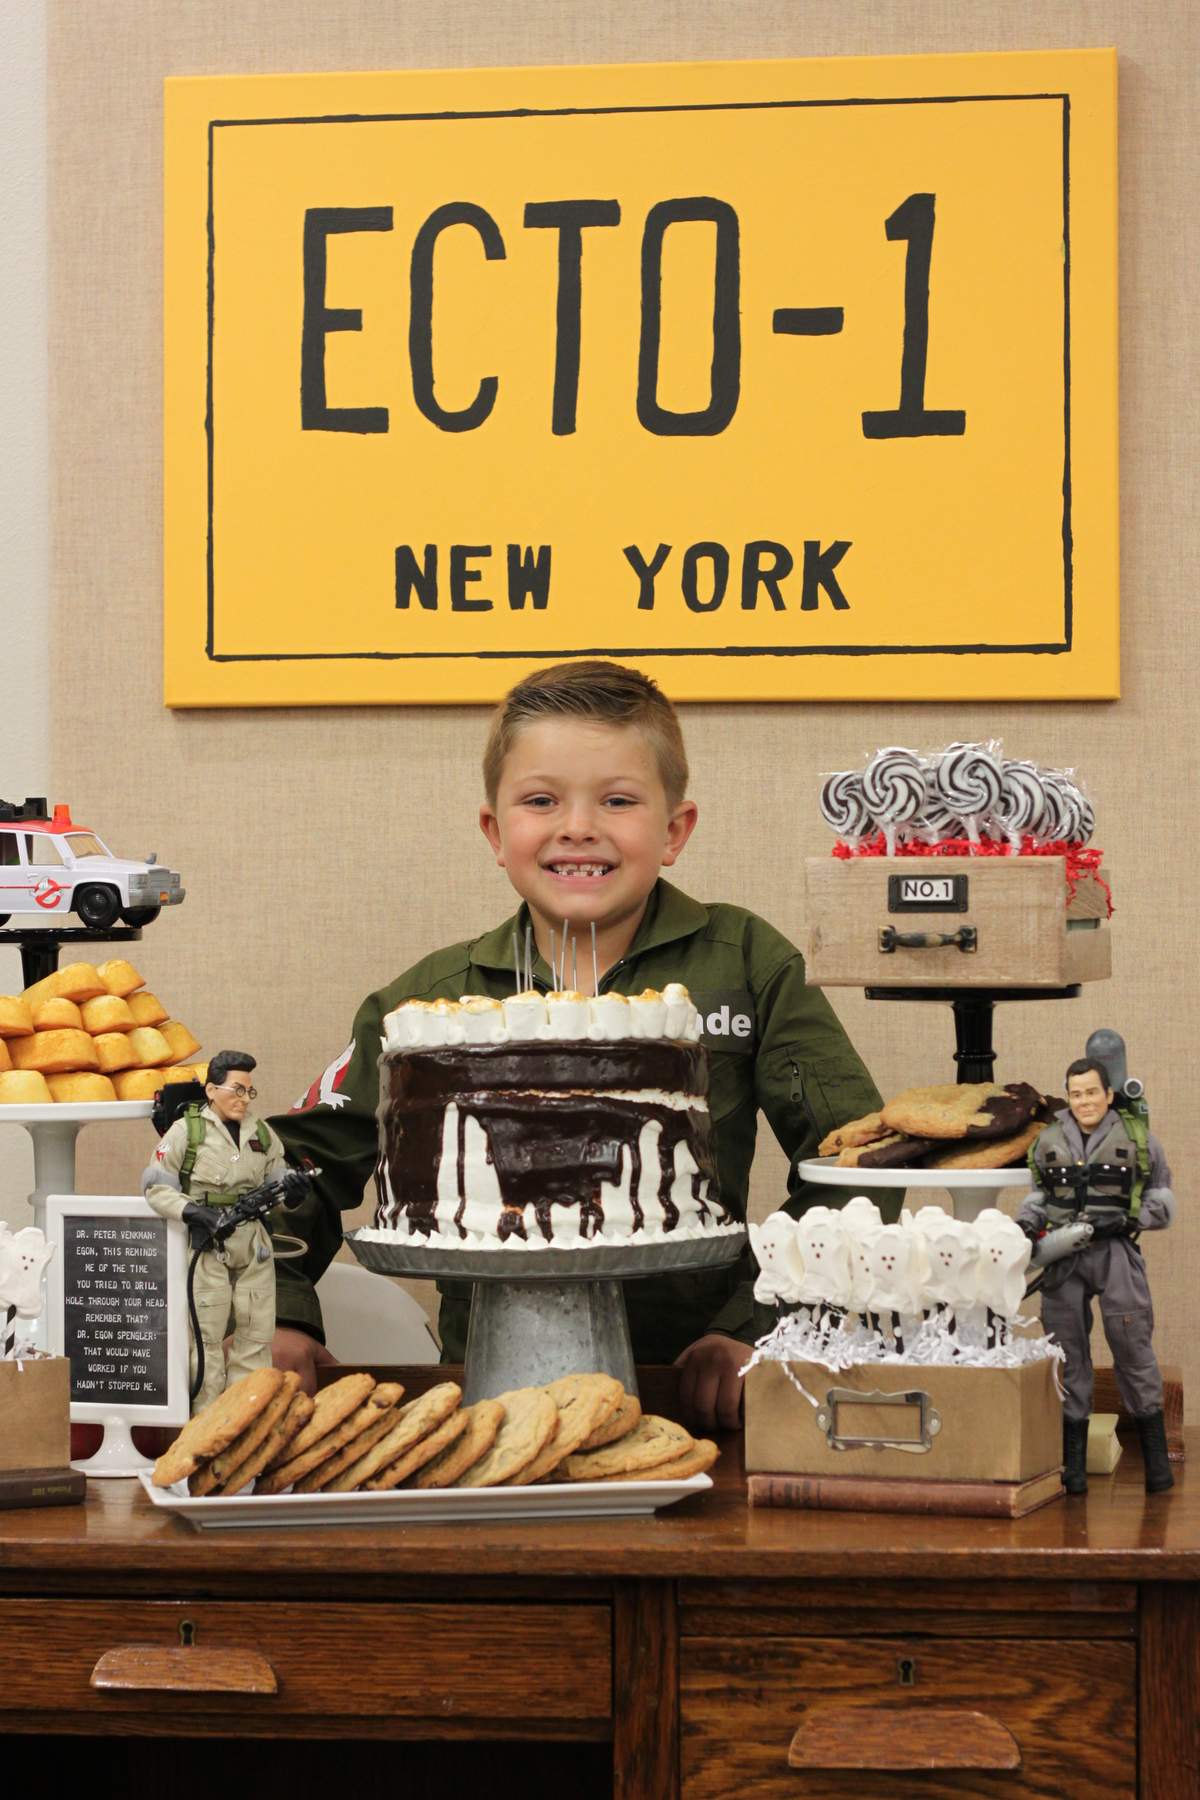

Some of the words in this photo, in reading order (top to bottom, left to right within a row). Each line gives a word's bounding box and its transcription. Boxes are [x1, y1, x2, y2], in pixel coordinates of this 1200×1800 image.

[301, 192, 967, 440] ECTO-1
[395, 543, 552, 611] NEW
[623, 541, 853, 614] YORK
[76, 1230, 89, 1239] DR.
[94, 1231, 116, 1239] PETER
[121, 1231, 156, 1240] VENKMAN:
[76, 1247, 99, 1256] EGON,
[103, 1247, 121, 1256] THIS
[125, 1248, 157, 1256] REMINDS
[85, 1264, 94, 1272] ME
[99, 1264, 107, 1272] OF
[112, 1264, 125, 1273] THE
[130, 1265, 148, 1273] TIME
[77, 1280, 90, 1289] YOU
[95, 1281, 117, 1289] TRIED
[122, 1281, 131, 1289] TO
[135, 1281, 157, 1290] DRILL
[66, 1297, 84, 1305] HOLE
[88, 1297, 119, 1306] THROUGH
[124, 1298, 141, 1306] YOUR
[146, 1298, 168, 1307] HEAD.
[86, 1314, 121, 1323] REMEMBER
[126, 1314, 148, 1323] THAT?
[77, 1331, 90, 1339] DR.
[95, 1331, 113, 1339] EGON
[117, 1331, 157, 1340] SPENGLER:
[84, 1347, 102, 1355] THAT
[106, 1348, 128, 1356] WOULD
[133, 1348, 151, 1357] HAVE
[88, 1364, 115, 1373] WORKED
[120, 1365, 129, 1373] IF
[133, 1365, 146, 1374] YOU
[77, 1380, 104, 1389] HADN'T
[108, 1381, 140, 1390] STOPPED
[144, 1382, 157, 1391] ME.
